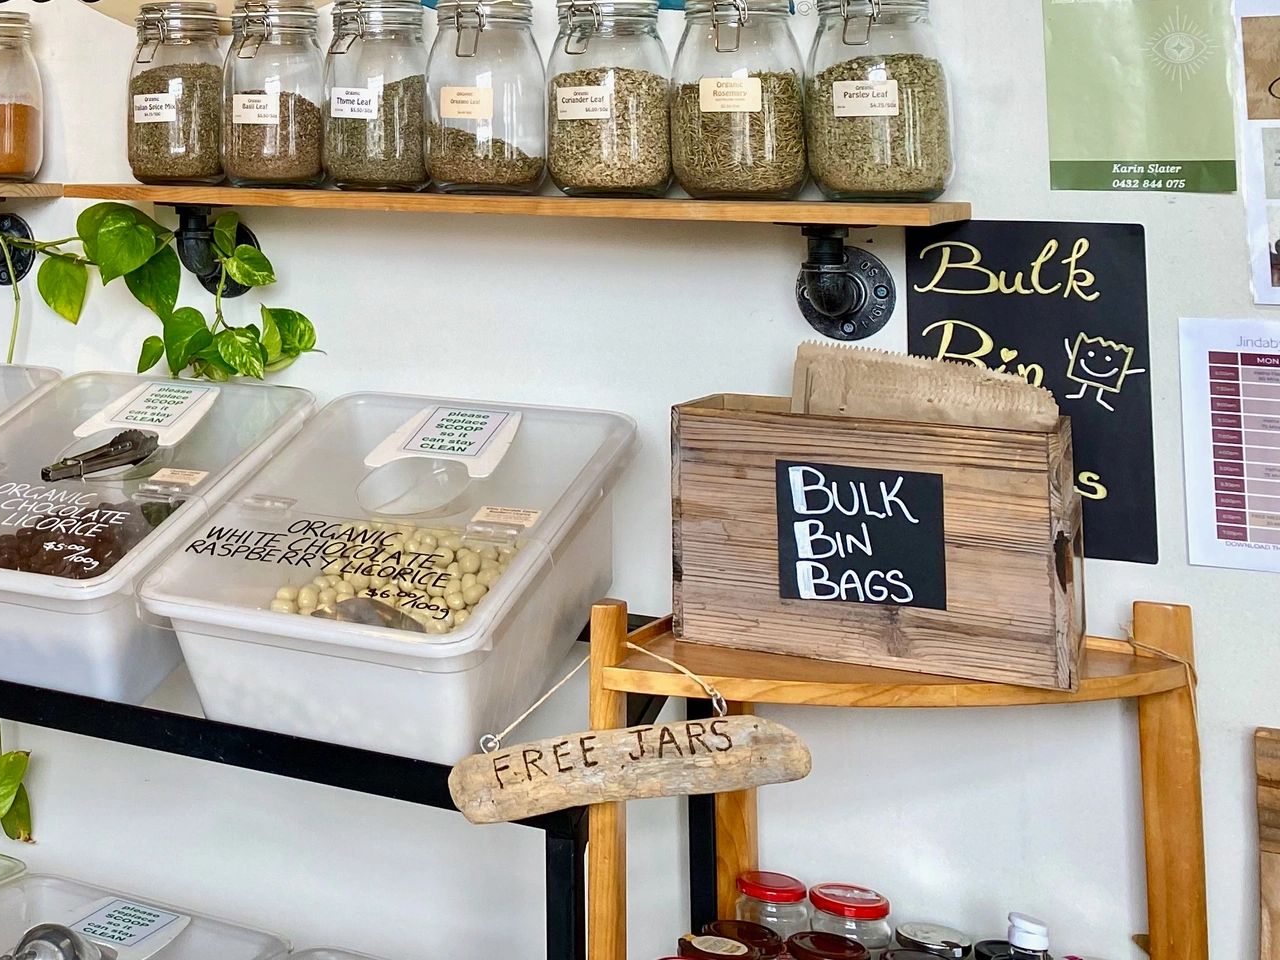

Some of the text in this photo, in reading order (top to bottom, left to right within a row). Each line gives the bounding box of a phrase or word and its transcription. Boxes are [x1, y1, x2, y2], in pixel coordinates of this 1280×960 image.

[337, 97, 355, 105] Thyme
[1112, 164, 1182, 173] Karin Slater
[1112, 179, 1185, 188] 0432 844 075
[913, 237, 1101, 301] Bulk
[441, 418, 487, 426] replace
[448, 411, 490, 419] please
[435, 423, 483, 432] SCOOP
[420, 443, 467, 452] CLEAN
[788, 465, 918, 523] BULK
[1, 498, 130, 525] CHOCOLATE
[1, 513, 109, 538] LICORICE
[287, 519, 402, 548] ORGANIC
[793, 520, 873, 560] BIN
[206, 526, 444, 570] WHITE CHOCOLATE
[1225, 541, 1270, 550] DOWNLOAD
[185, 539, 451, 589] RASPBERRY LICORICE
[796, 560, 913, 603] BAGS
[492, 720, 734, 789] FREE JARS
[112, 909, 155, 923] replace
[121, 906, 160, 918] please
[105, 914, 149, 927] SCOOP
[83, 928, 126, 941] CLEAN
[88, 922, 136, 937] can stay
